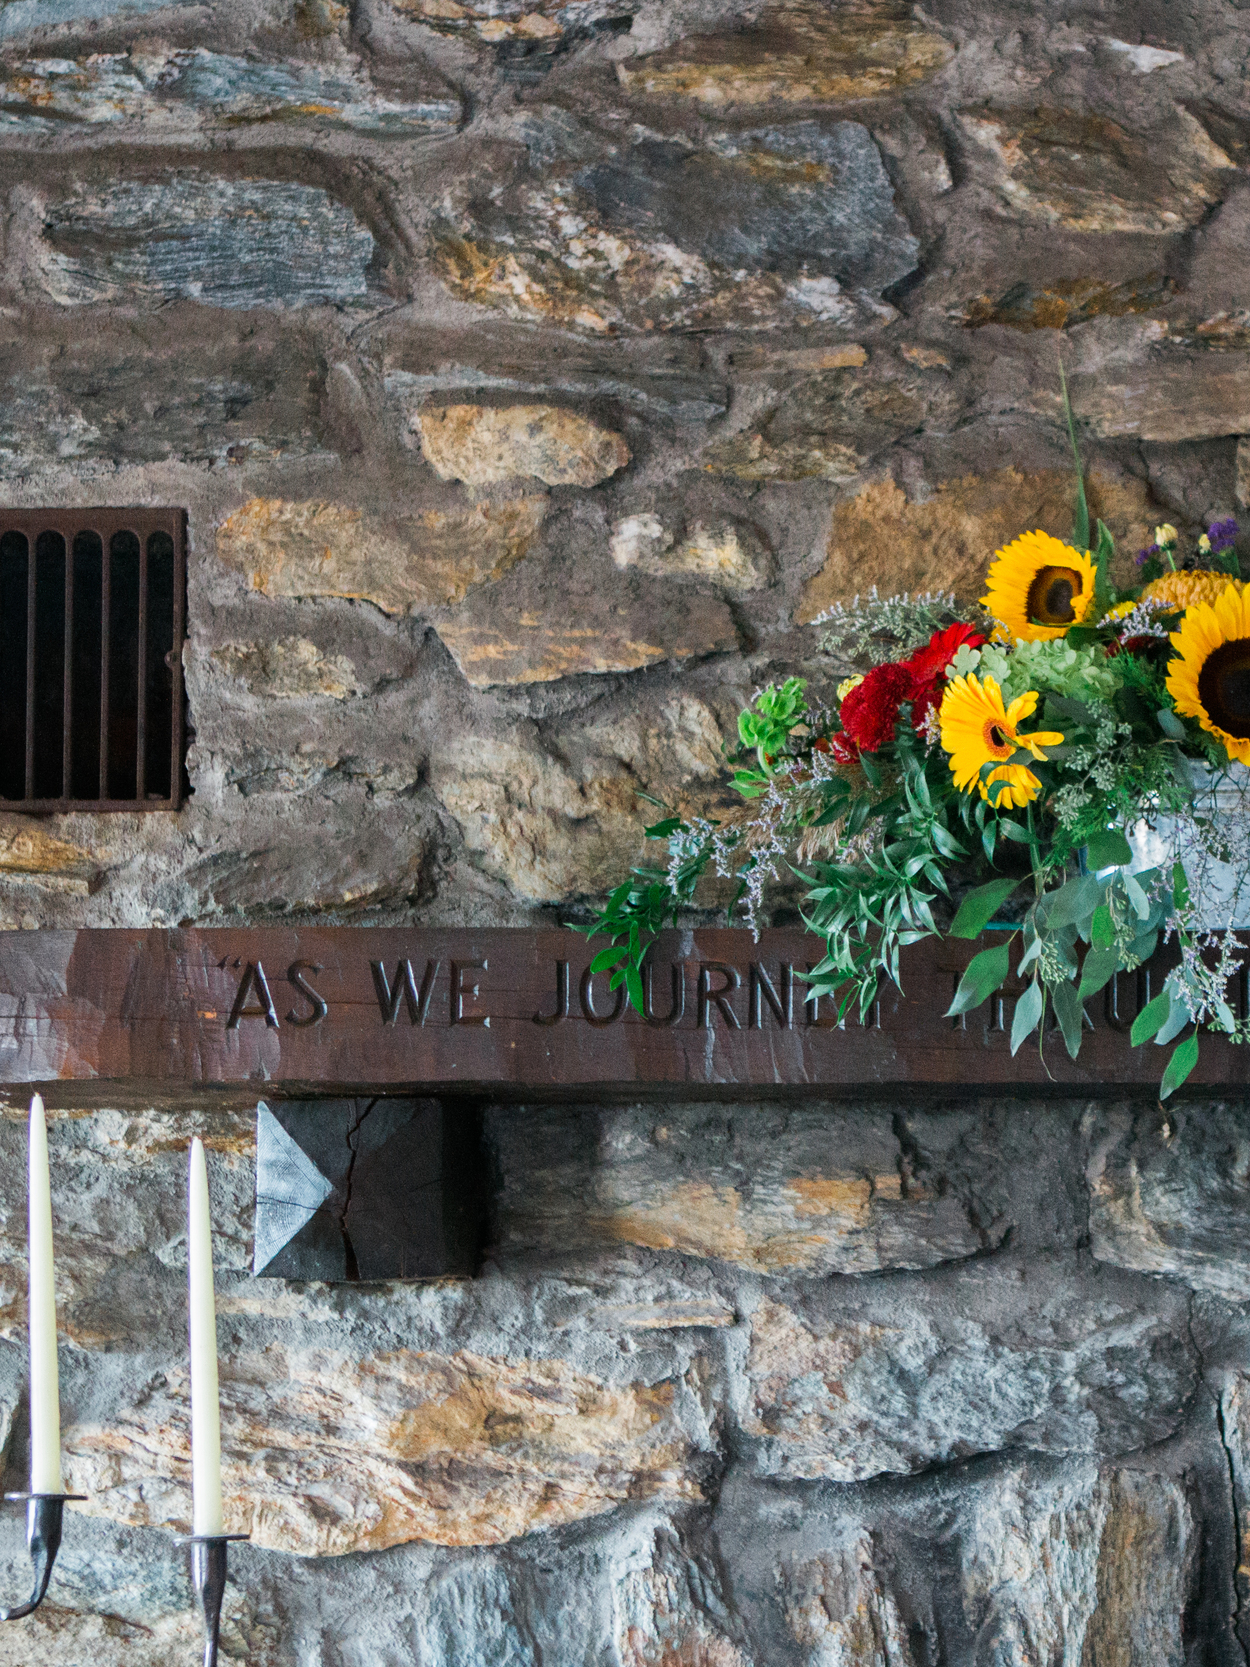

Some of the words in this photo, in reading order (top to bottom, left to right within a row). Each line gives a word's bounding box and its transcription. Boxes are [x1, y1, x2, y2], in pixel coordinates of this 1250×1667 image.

[369, 958, 491, 1029] WE
[532, 958, 897, 1032] JOURNEY
[937, 962, 1151, 1034] THU
